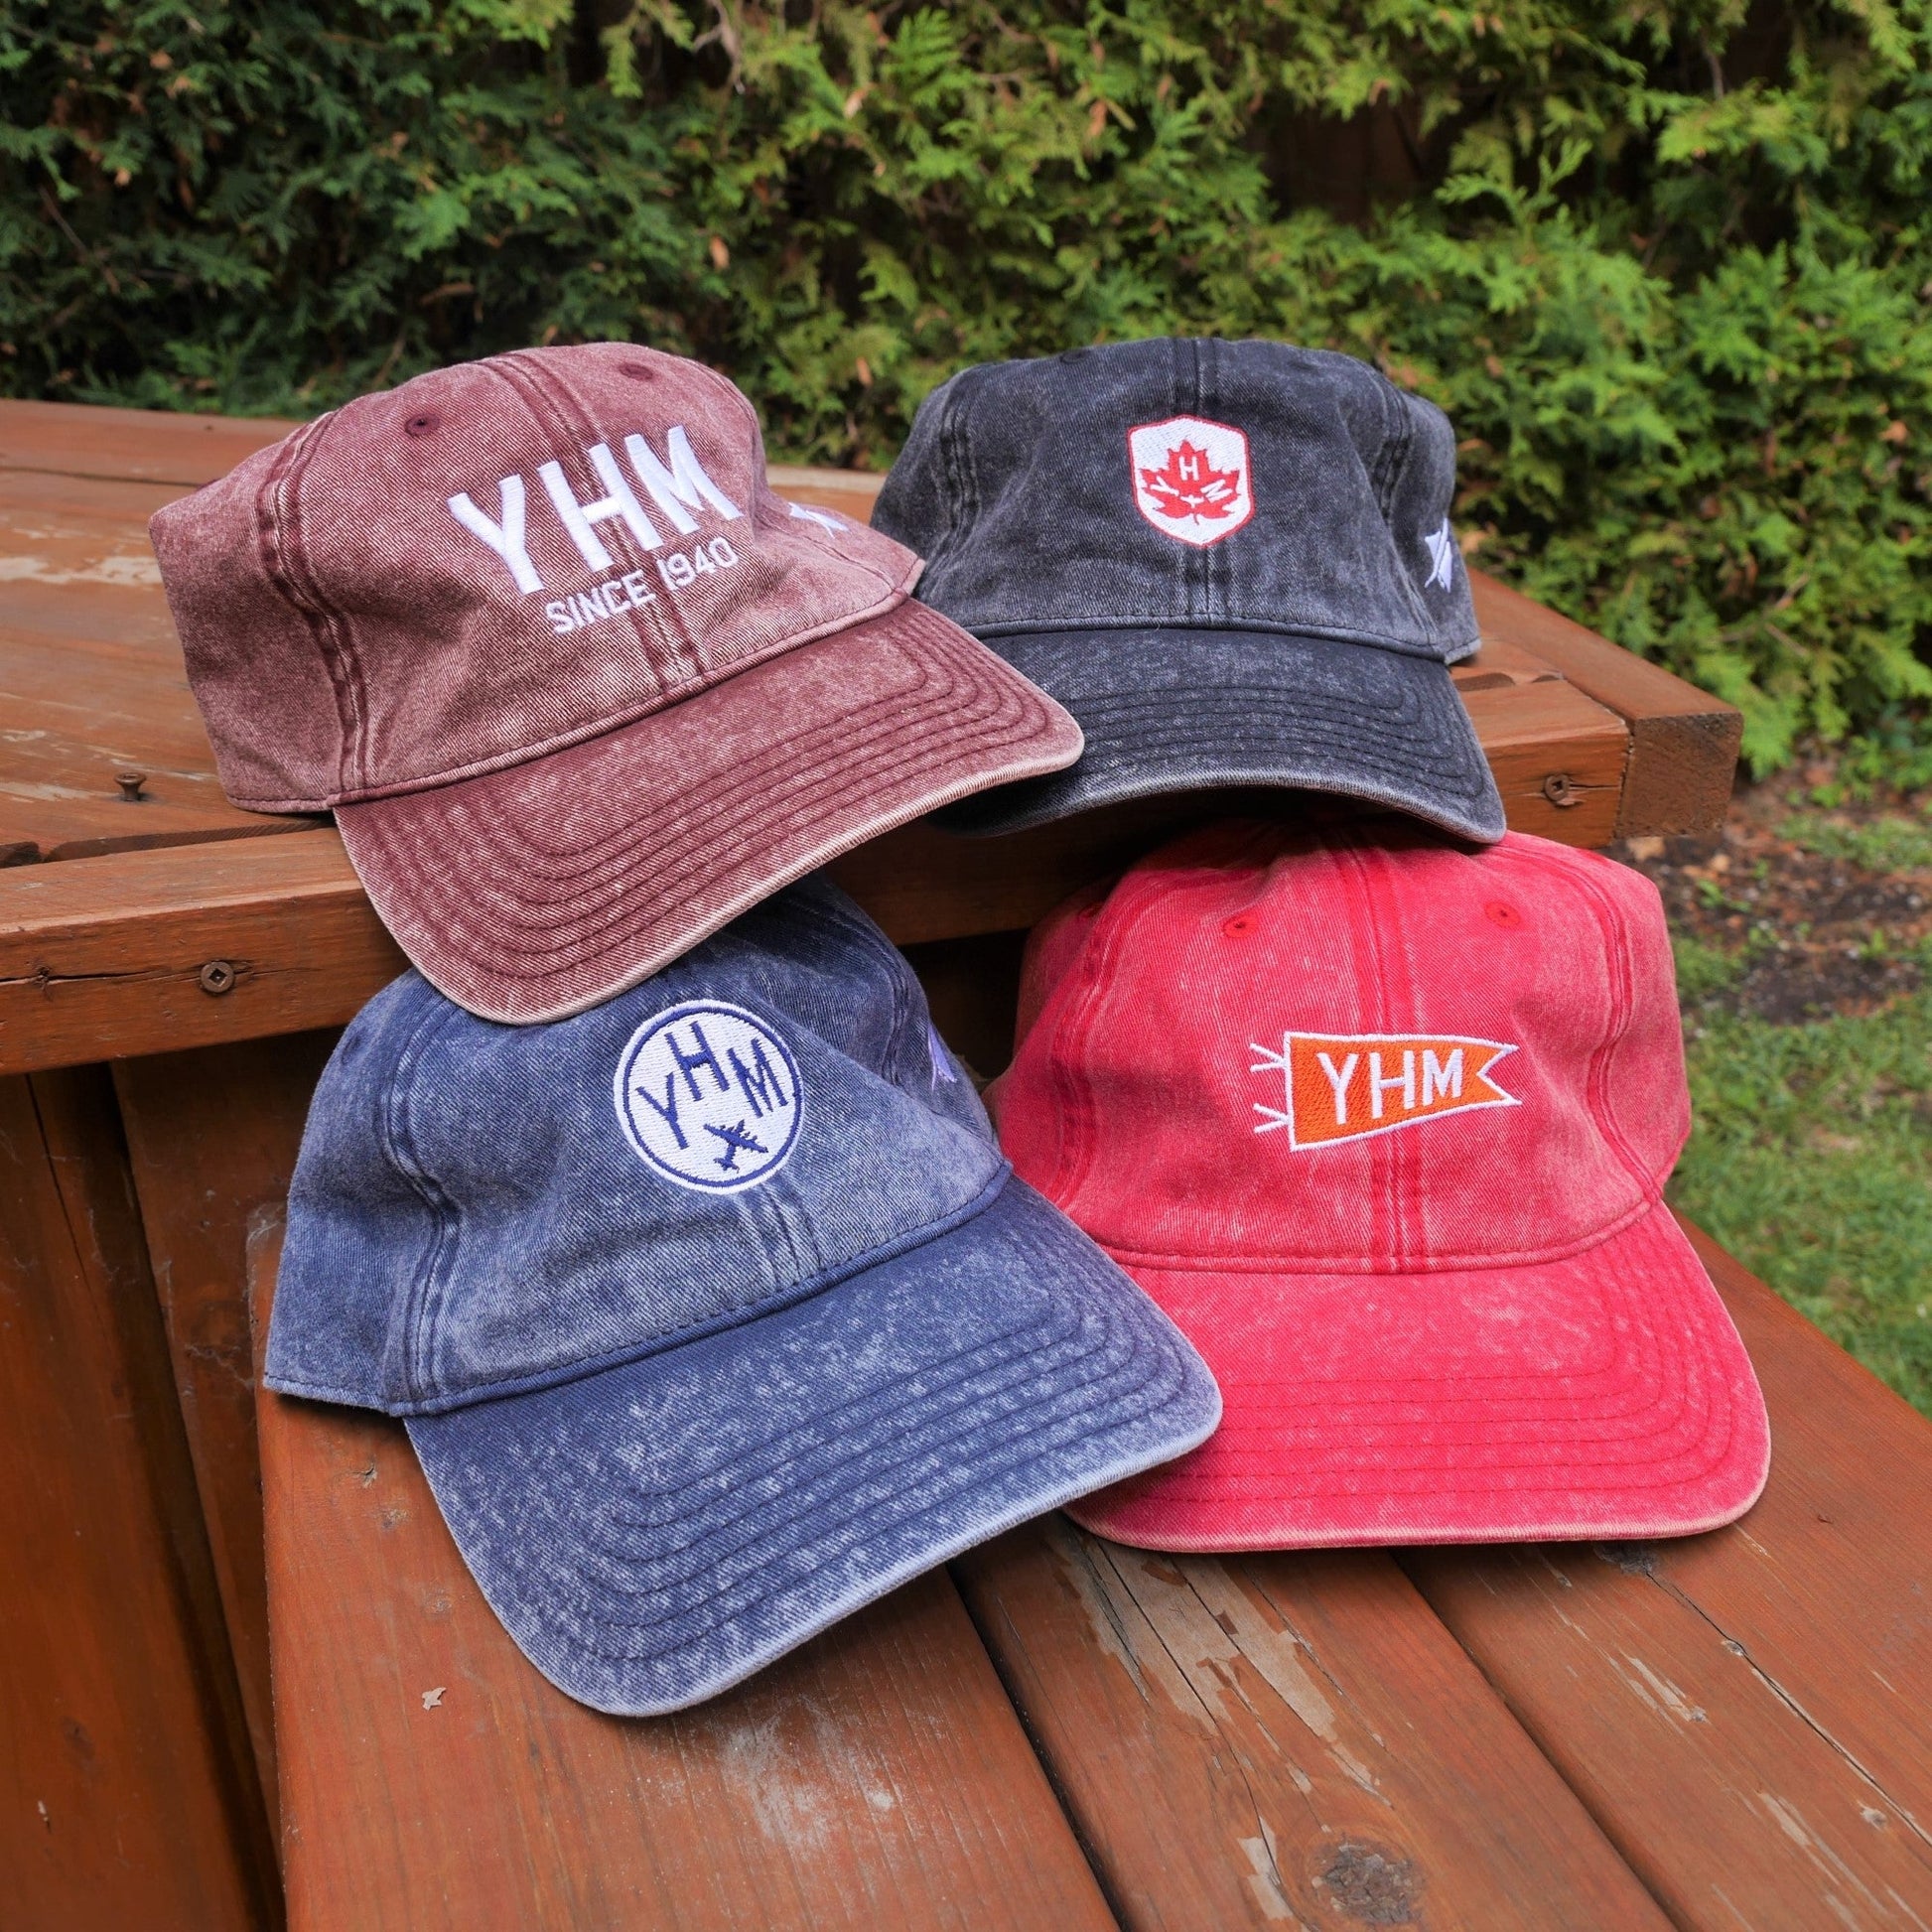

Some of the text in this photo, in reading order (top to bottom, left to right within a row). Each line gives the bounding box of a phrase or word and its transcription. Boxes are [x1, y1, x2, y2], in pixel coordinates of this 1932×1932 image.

[447, 425, 744, 596] YHM
[546, 536, 740, 634] SINCE 1940
[635, 1021, 788, 1150] YHM
[1316, 1048, 1463, 1125] YHM
